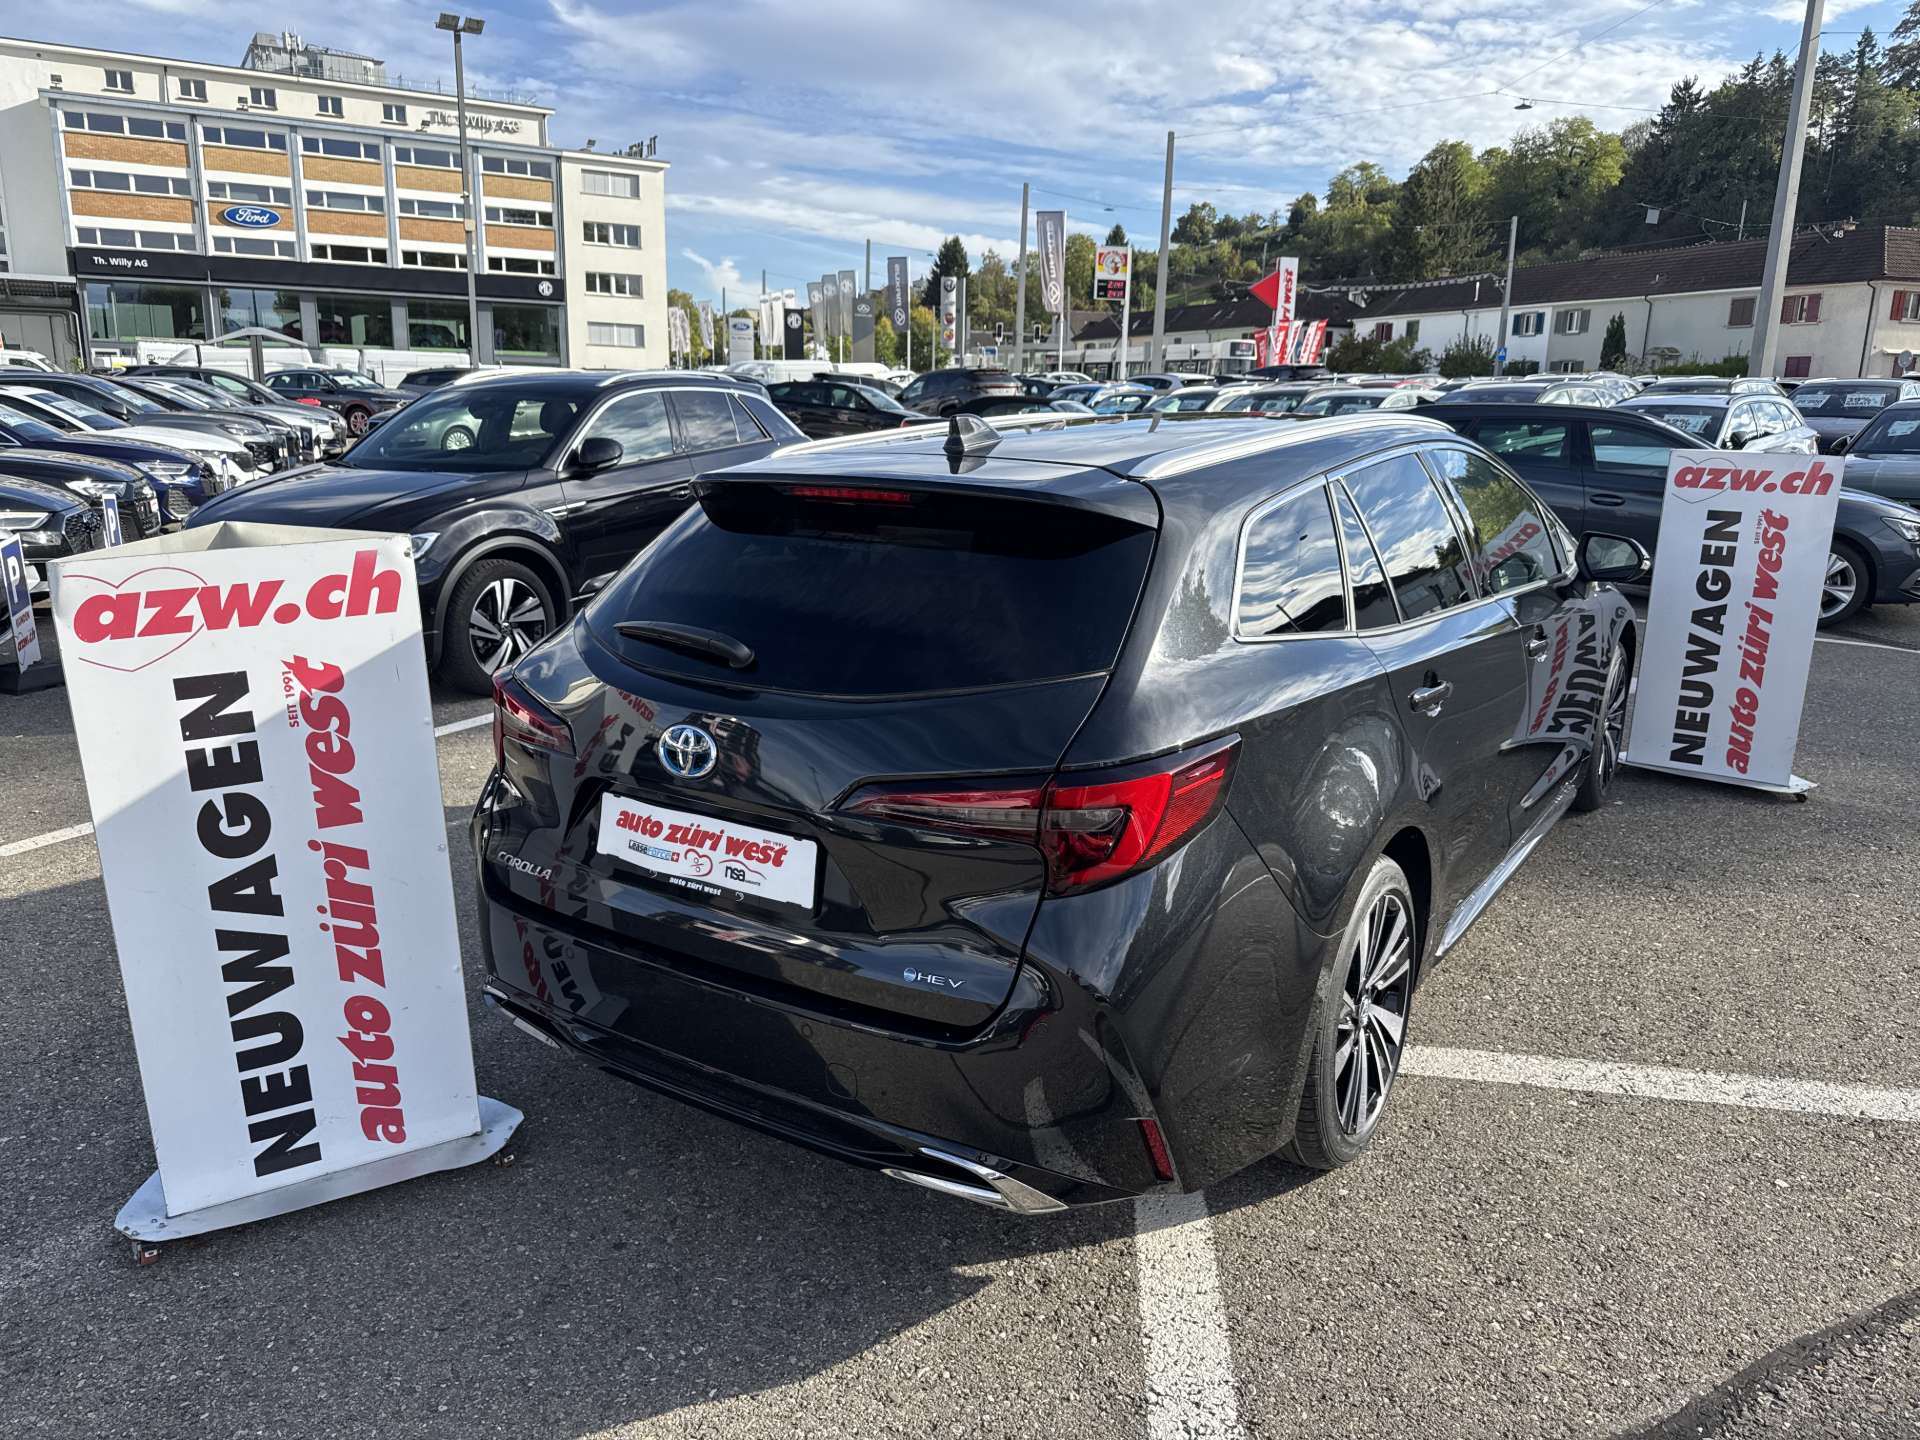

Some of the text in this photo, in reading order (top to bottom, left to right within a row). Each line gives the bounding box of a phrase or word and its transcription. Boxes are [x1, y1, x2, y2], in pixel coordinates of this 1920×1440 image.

[235, 209, 269, 224] Ford
[1833, 230, 1844, 238] 48
[93, 256, 148, 268] Th. Willy AG
[1284, 268, 1293, 304] west
[1674, 462, 1834, 495] azw.ch
[73, 550, 402, 643] azw.ch
[1669, 509, 1743, 766] NEUWAGEN
[1726, 508, 1789, 775] auto züri west
[282, 671, 299, 728] SEIT 1991
[616, 810, 788, 868] auto züri west
[497, 851, 552, 880] COROLLA
[725, 865, 746, 882] nsa
[280, 654, 406, 1144] auto züri west
[669, 876, 722, 896] auto züri west
[173, 670, 322, 1178] NEUWAGEN
[917, 972, 967, 989] HEV
